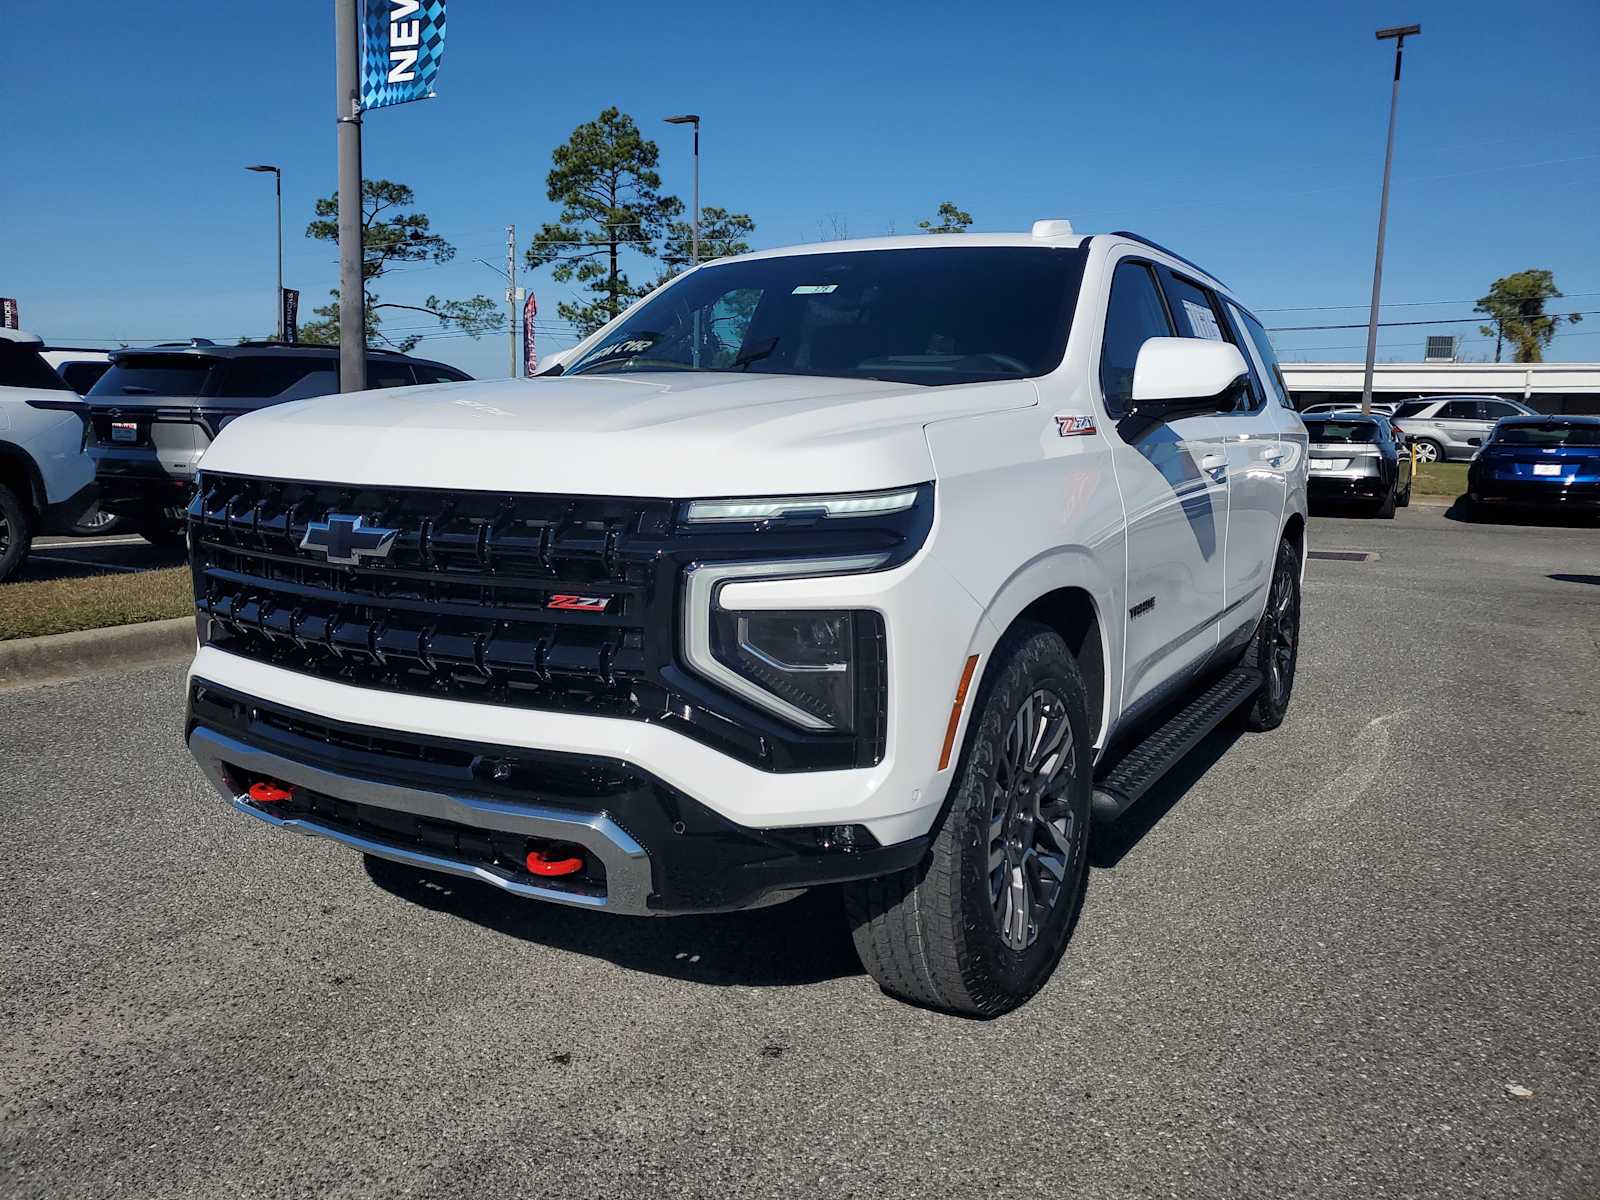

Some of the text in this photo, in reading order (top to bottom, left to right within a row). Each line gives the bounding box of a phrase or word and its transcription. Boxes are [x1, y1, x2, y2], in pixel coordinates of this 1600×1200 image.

[4, 301, 12, 328] TRUCKS
[1055, 416, 1096, 437] Z71
[547, 595, 610, 611] Z71
